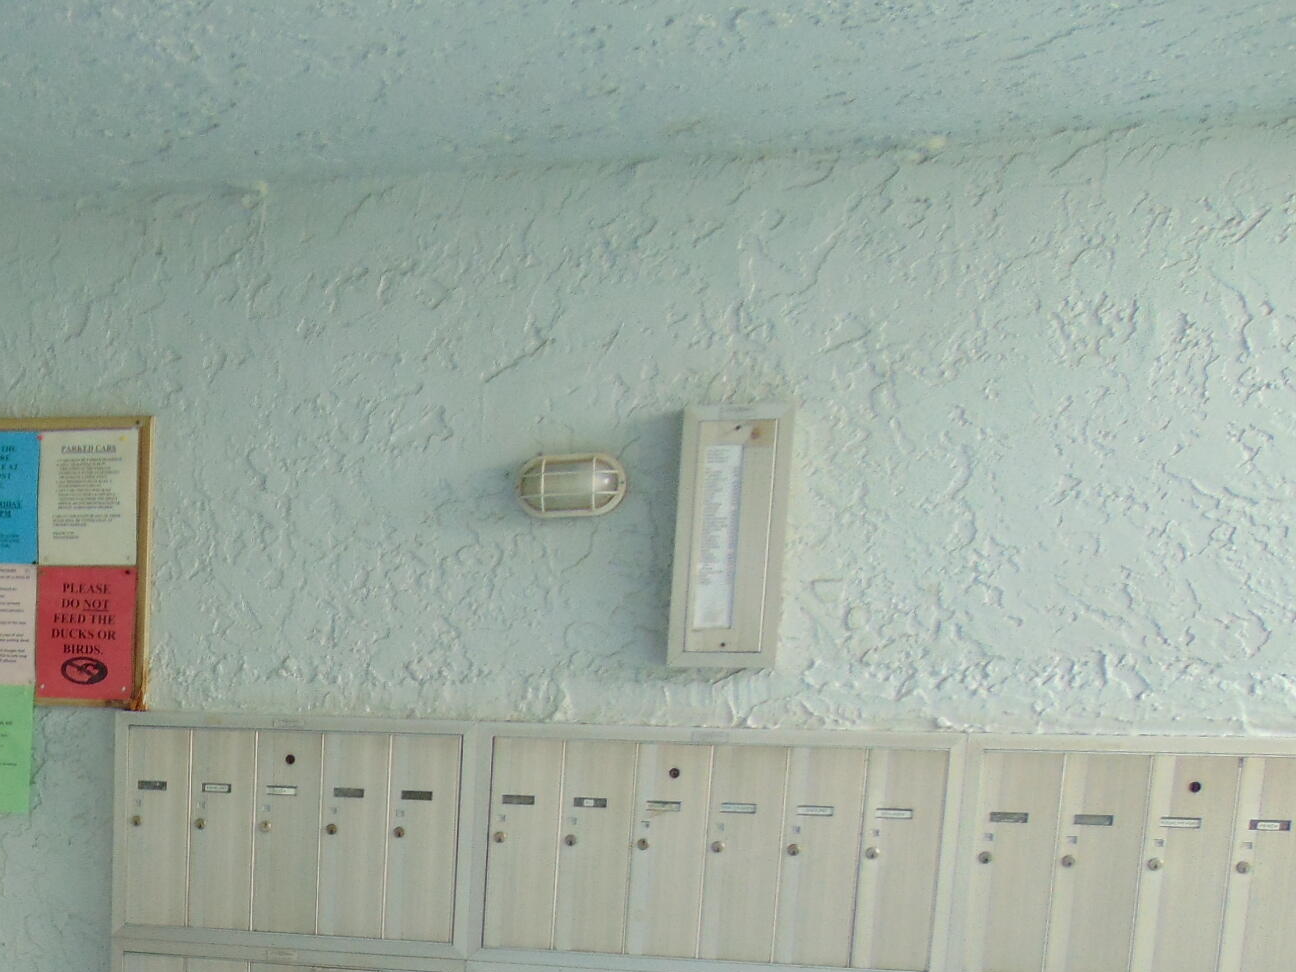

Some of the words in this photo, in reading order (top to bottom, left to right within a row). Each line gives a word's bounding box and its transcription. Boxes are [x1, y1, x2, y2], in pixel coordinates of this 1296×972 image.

[63, 583, 111, 594] PLEASE
[61, 599, 80, 609] DO
[84, 599, 110, 610] NOT
[53, 613, 86, 624] FEED
[90, 614, 116, 625] THE
[51, 628, 94, 640] DUCKS
[97, 630, 116, 640] OR
[63, 644, 104, 655] BIRDS.
